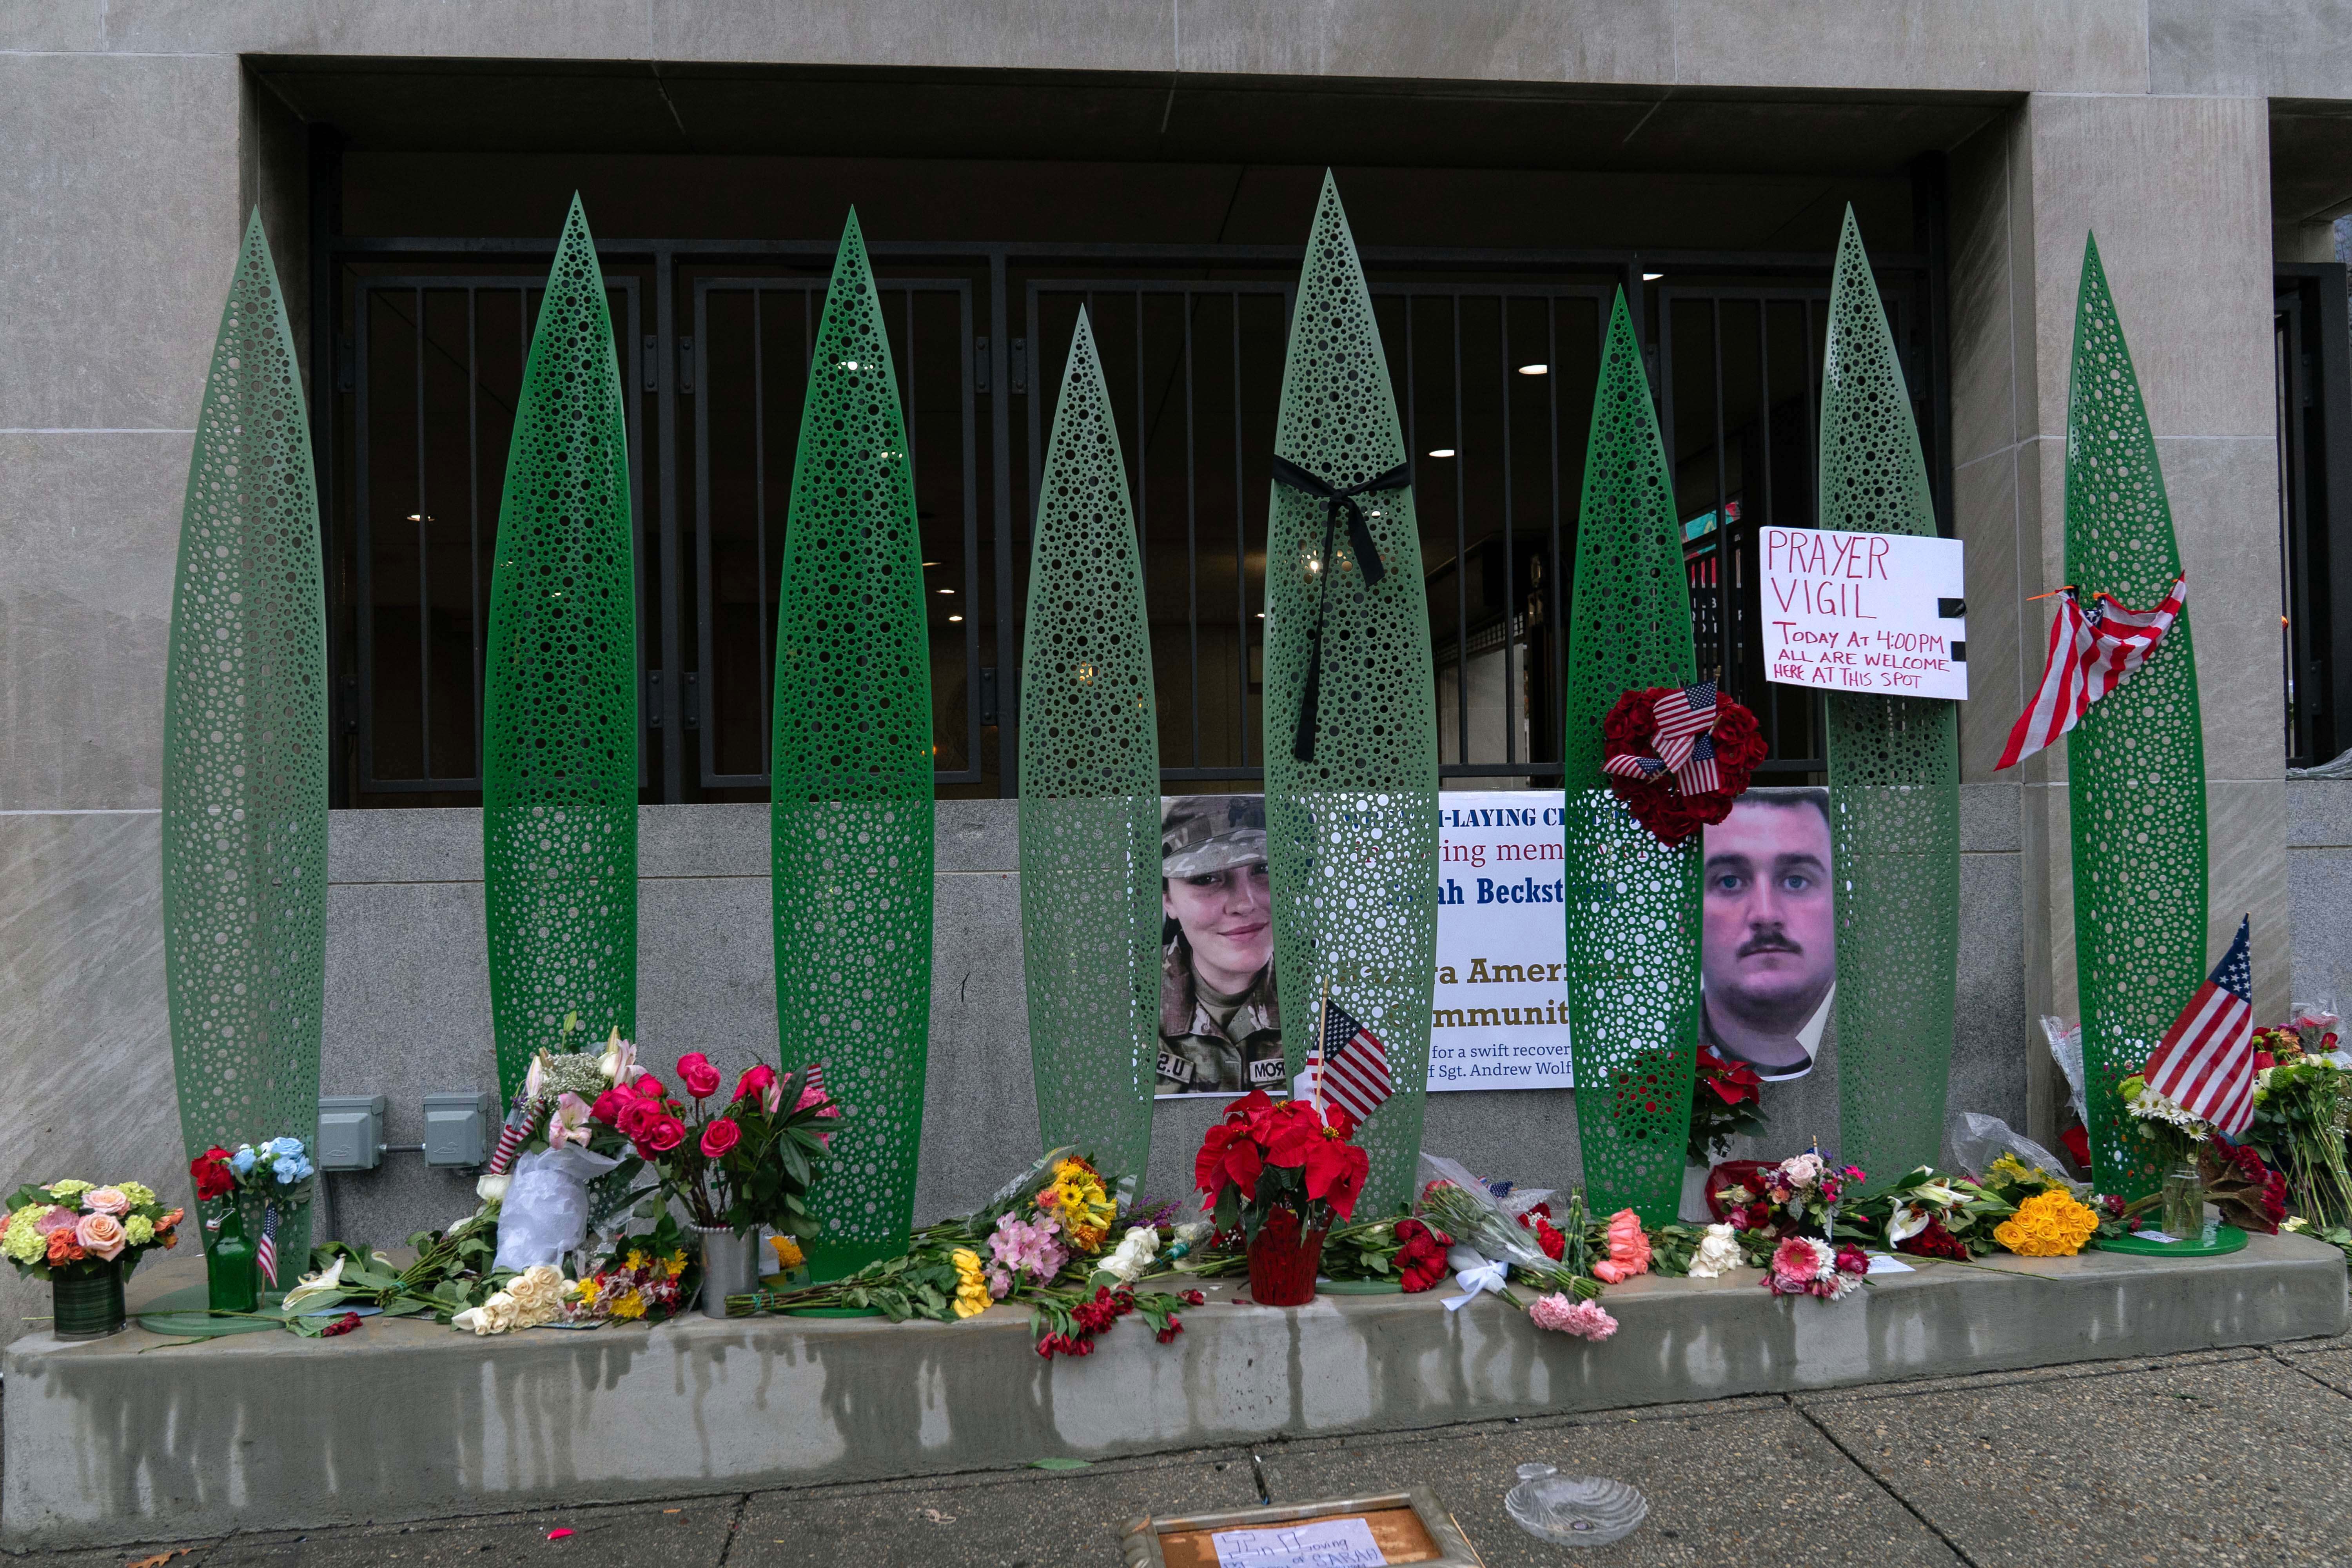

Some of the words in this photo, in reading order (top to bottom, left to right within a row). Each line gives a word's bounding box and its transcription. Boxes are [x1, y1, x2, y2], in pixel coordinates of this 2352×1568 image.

[1769, 530, 1890, 580] PRAYER
[1771, 577, 1877, 619] VIGIL
[1772, 621, 1839, 649] TODAY
[1847, 631, 1870, 648] AT
[1778, 648, 1813, 663] ALL
[1819, 651, 1857, 665] ARE
[1864, 653, 1951, 672] WELCOME
[1774, 664, 1805, 681] HERE
[1812, 666, 1836, 683] AT
[1839, 667, 1873, 687] THIS
[1880, 672, 1922, 689] SPOT
[1438, 839, 1486, 868] ing
[1432, 1045, 1454, 1059] for
[1457, 1048, 1466, 1058] a
[1470, 1043, 1509, 1058] swift
[1439, 1064, 1466, 1081] Sgt.
[1469, 1062, 1532, 1077] Andrew
